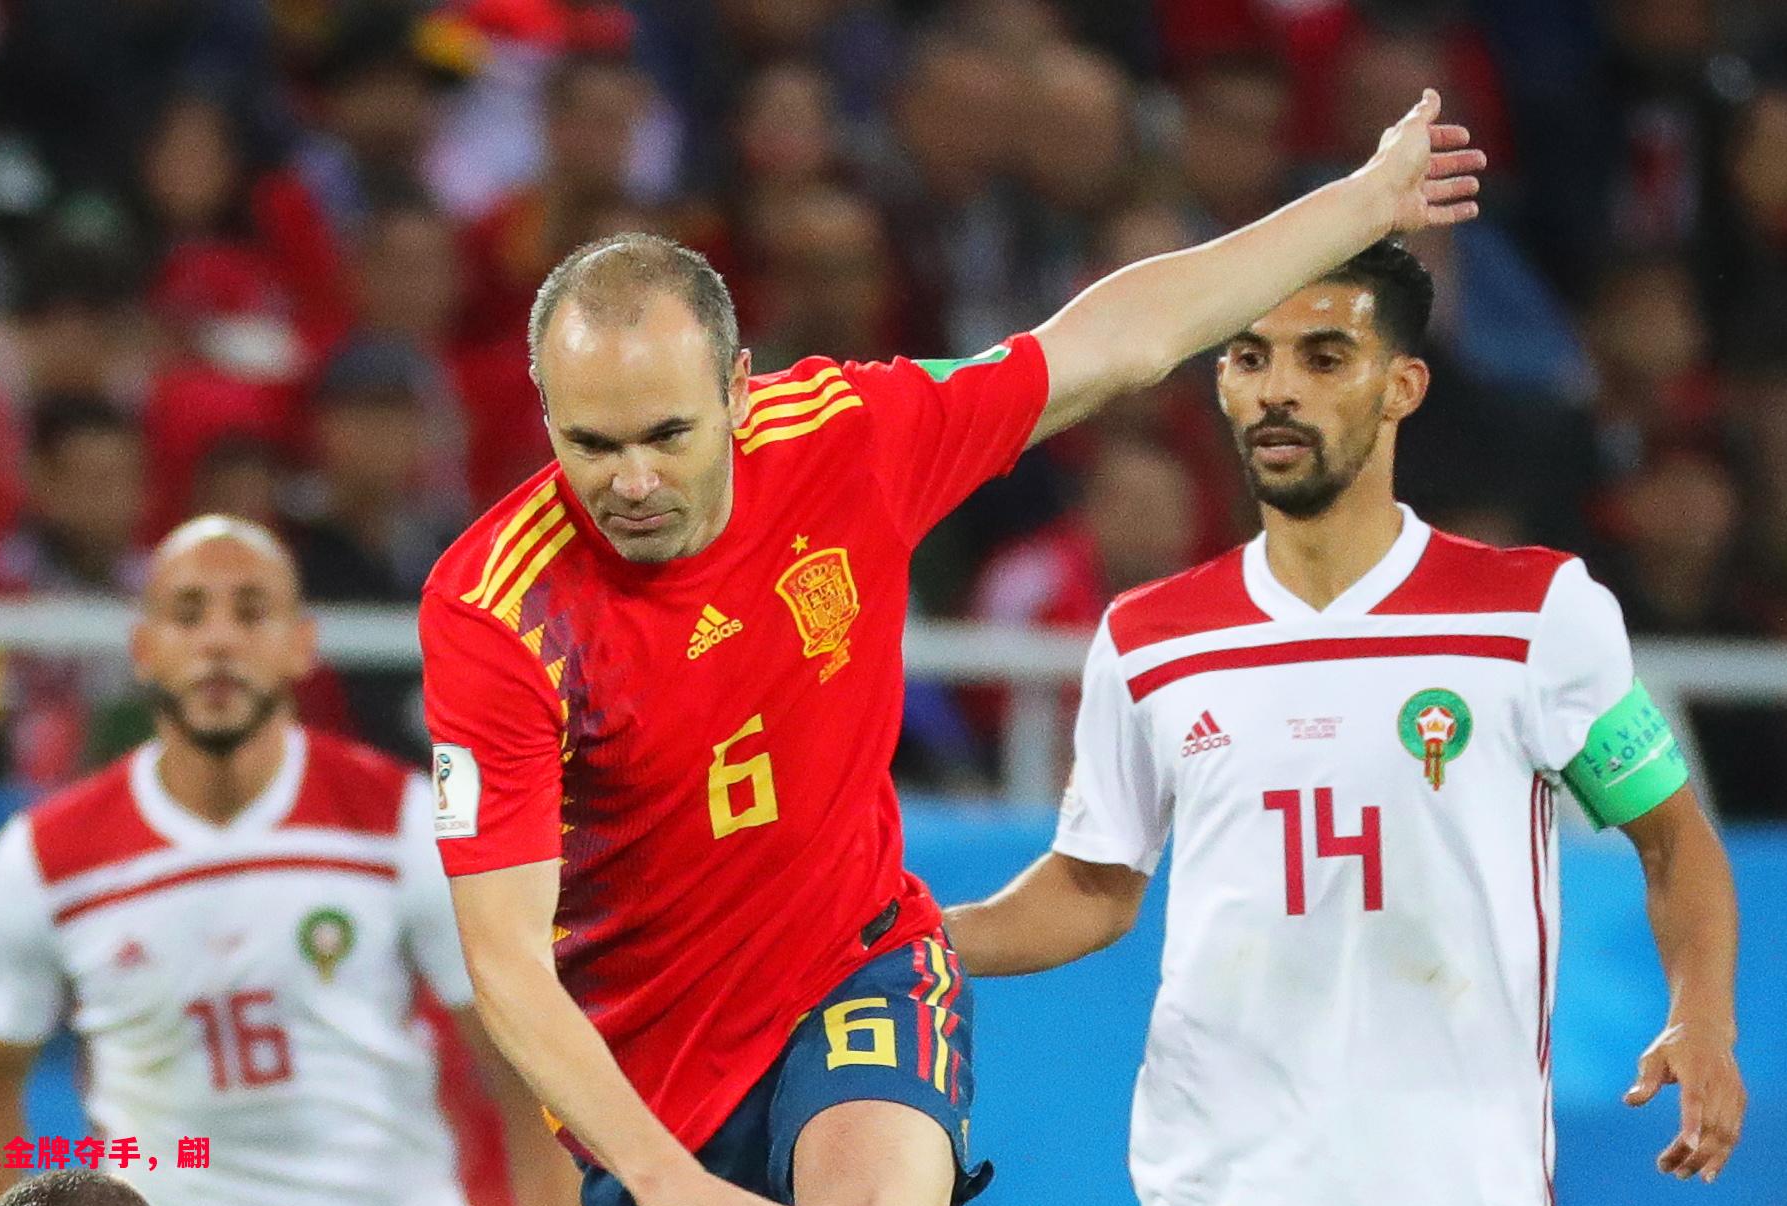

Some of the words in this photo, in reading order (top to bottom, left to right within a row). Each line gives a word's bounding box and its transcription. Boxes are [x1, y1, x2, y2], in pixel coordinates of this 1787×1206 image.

[687, 618, 744, 661] adidas
[708, 712, 779, 840] 6
[1181, 734, 1232, 758] adidas
[1262, 786, 1384, 917] 14
[184, 989, 295, 1093] 16
[822, 996, 898, 1071] 6
